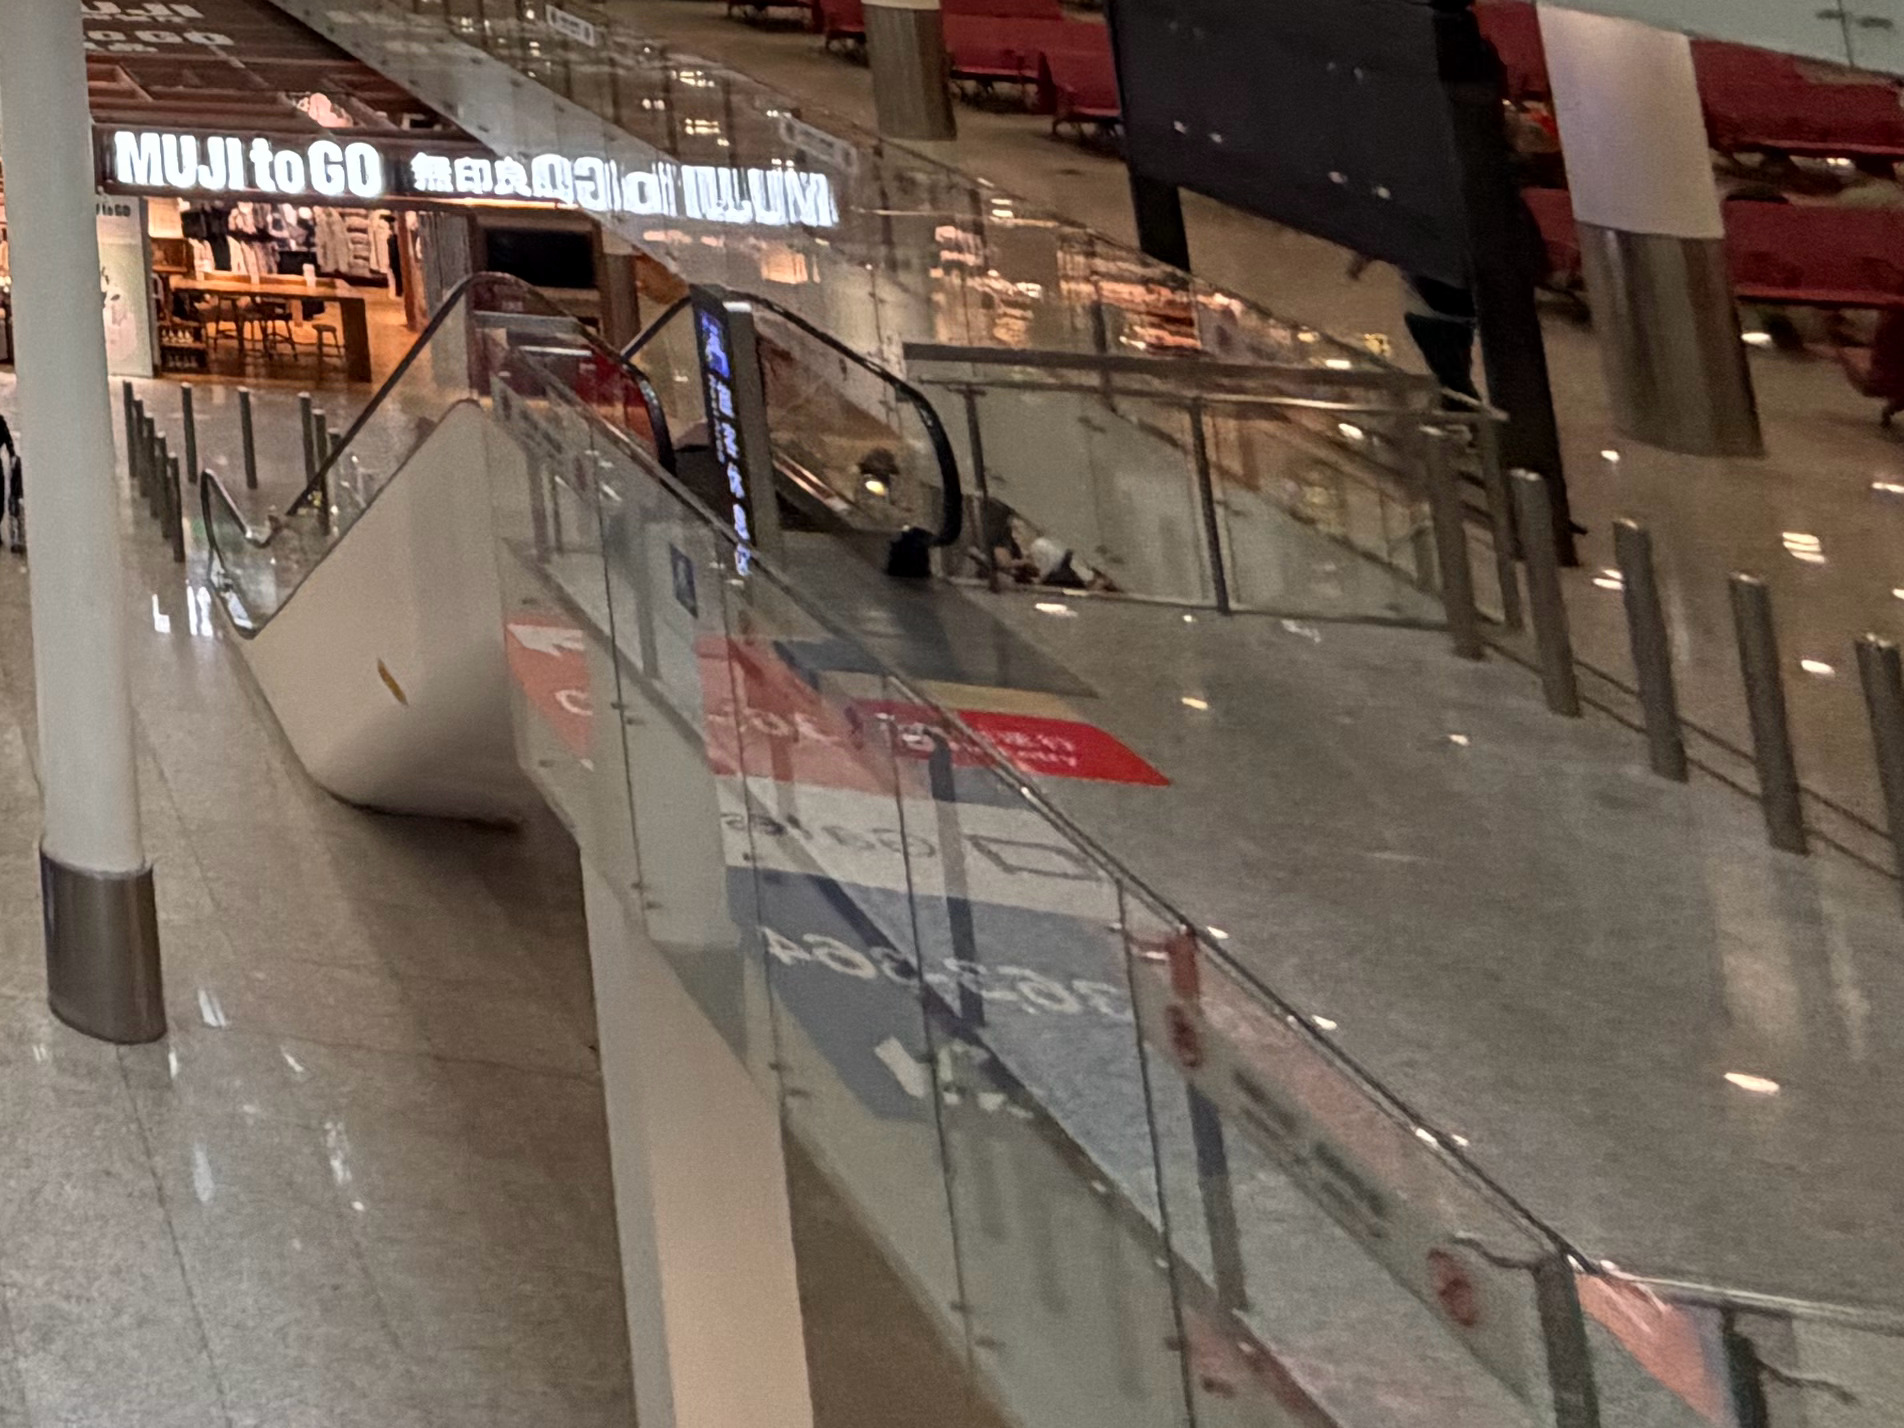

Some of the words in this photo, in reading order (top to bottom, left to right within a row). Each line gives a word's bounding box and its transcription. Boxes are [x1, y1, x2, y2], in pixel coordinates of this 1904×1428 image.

[114, 131, 243, 190] MUJI
[249, 138, 306, 194] to
[307, 140, 383, 198] GO
